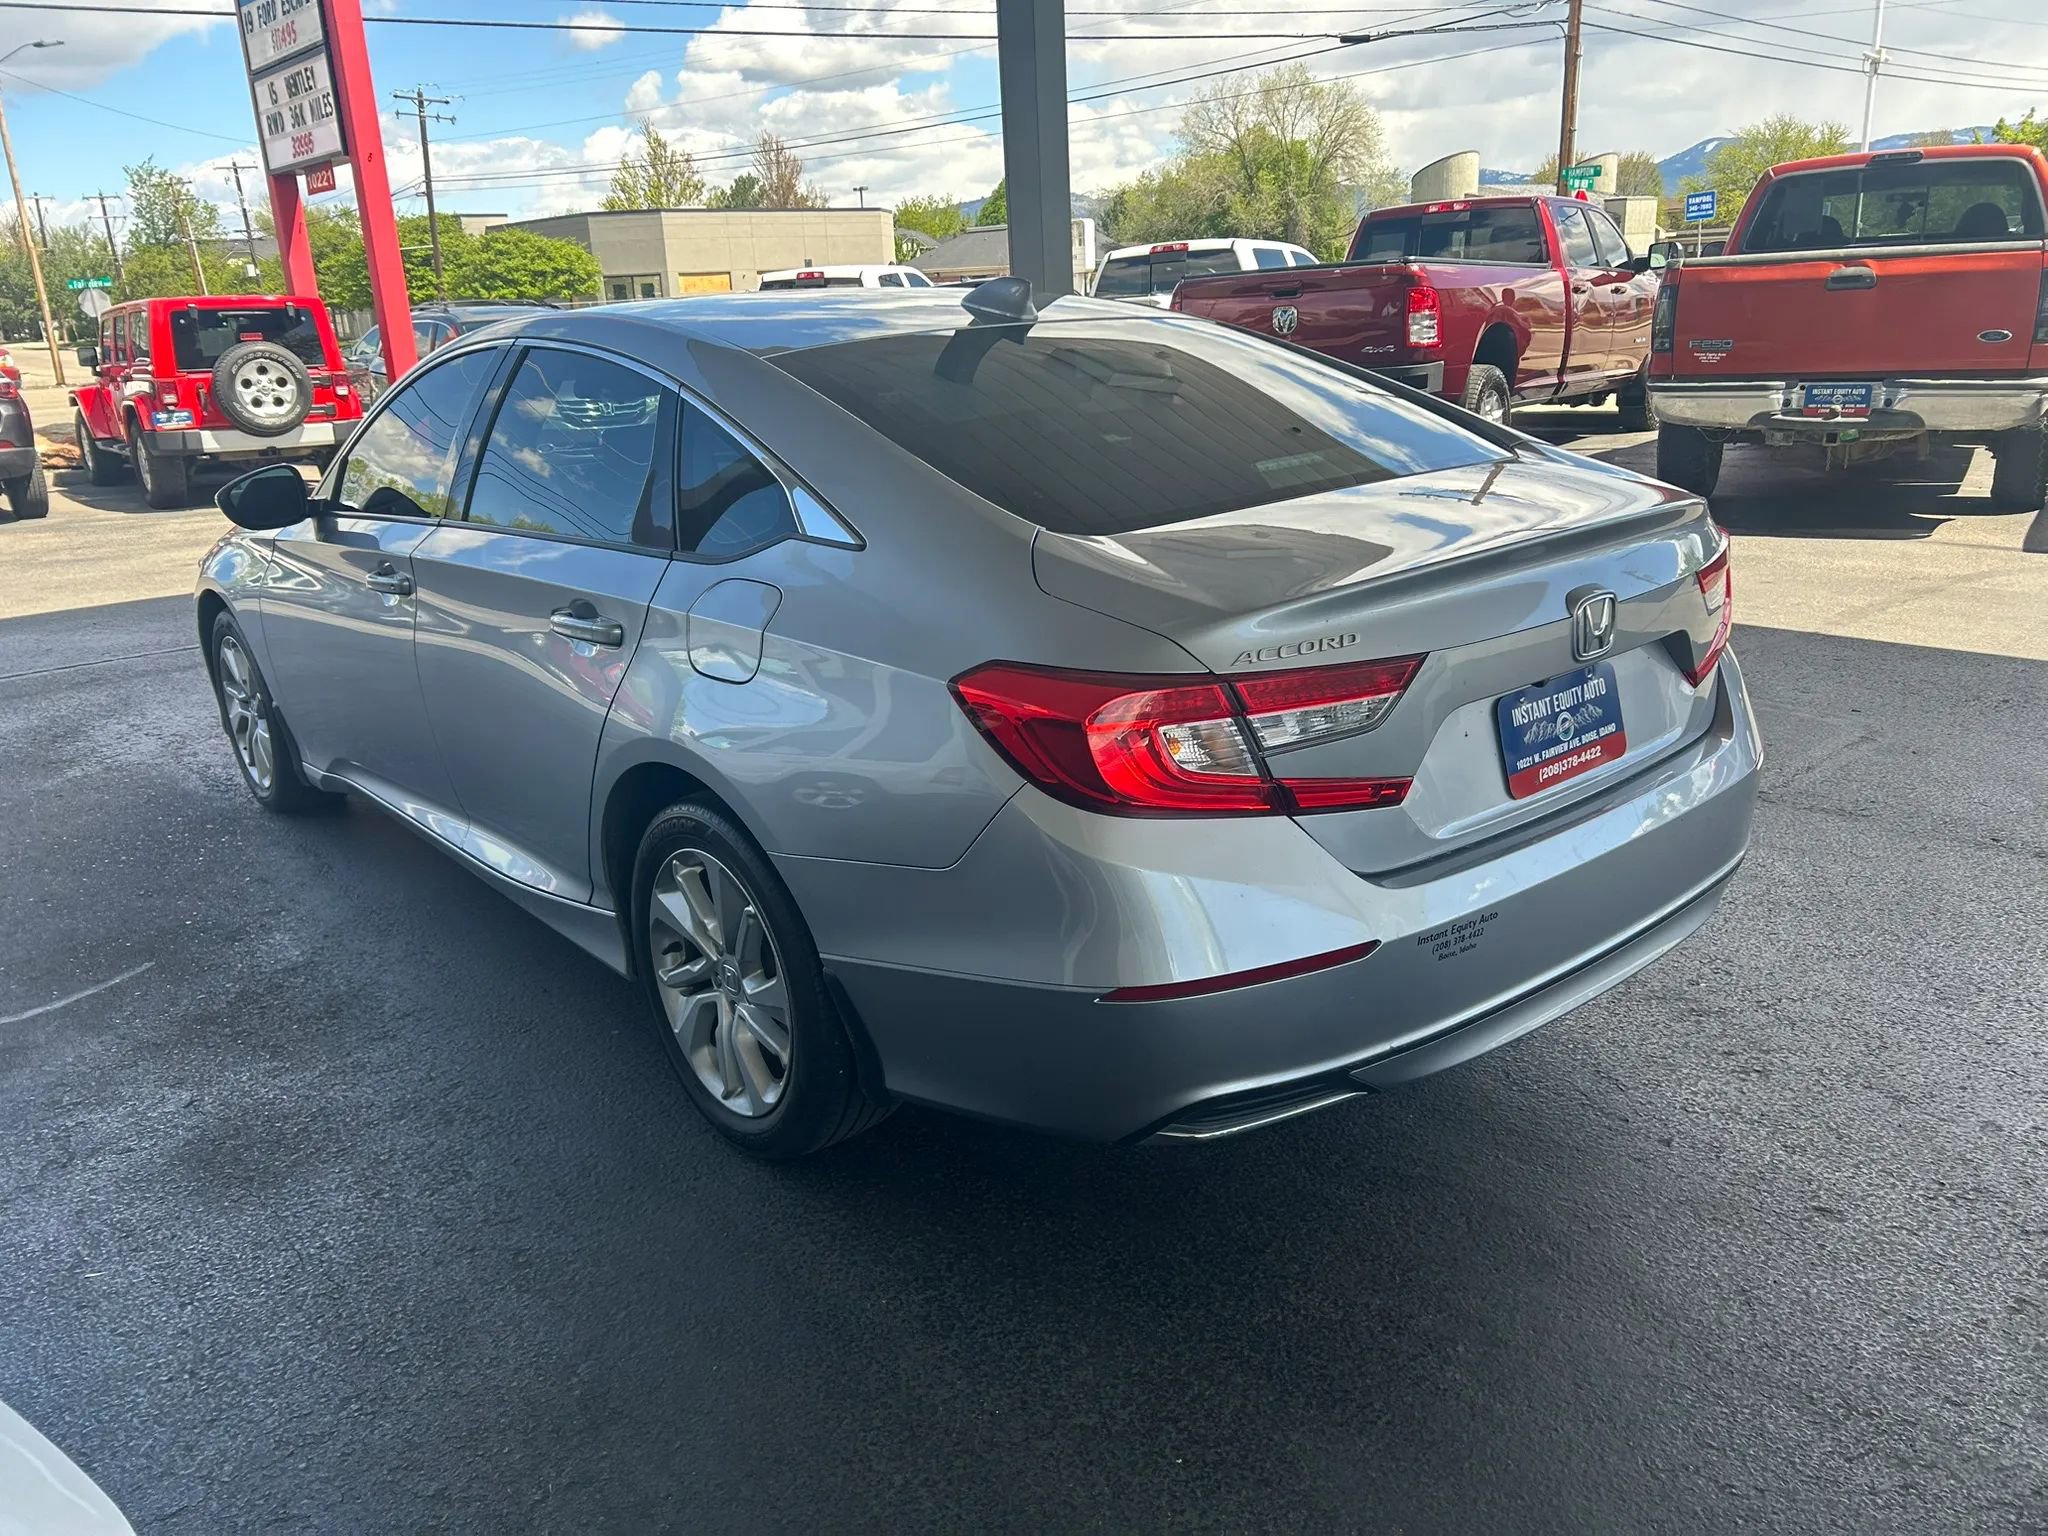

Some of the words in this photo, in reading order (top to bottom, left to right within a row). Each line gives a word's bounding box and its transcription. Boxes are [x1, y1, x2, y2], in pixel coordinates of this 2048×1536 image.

[243, 10, 254, 34] 19
[257, 0, 277, 28] FORD
[281, 0, 310, 16] ESC
[267, 81, 278, 105] 15
[284, 65, 317, 99] BENTLEY
[266, 110, 285, 136] RWD
[308, 92, 334, 122] MILES
[307, 169, 333, 189] 10221
[1231, 632, 1361, 667] ACCORD
[1512, 697, 1552, 727] INSTANT
[1553, 685, 1582, 713] EQUITY
[1584, 677, 1607, 701] AUTO
[1516, 757, 1533, 771] 10221
[1542, 741, 1569, 761] FAIRVIEW
[1582, 731, 1598, 744] BOISE,
[1599, 722, 1617, 737] IDAHO
[1538, 745, 1601, 783] (208)378-4422
[1416, 929, 1449, 946] Instant
[1450, 920, 1477, 936] Equity
[1478, 911, 1499, 925] Auto
[1432, 939, 1452, 955] (208)
